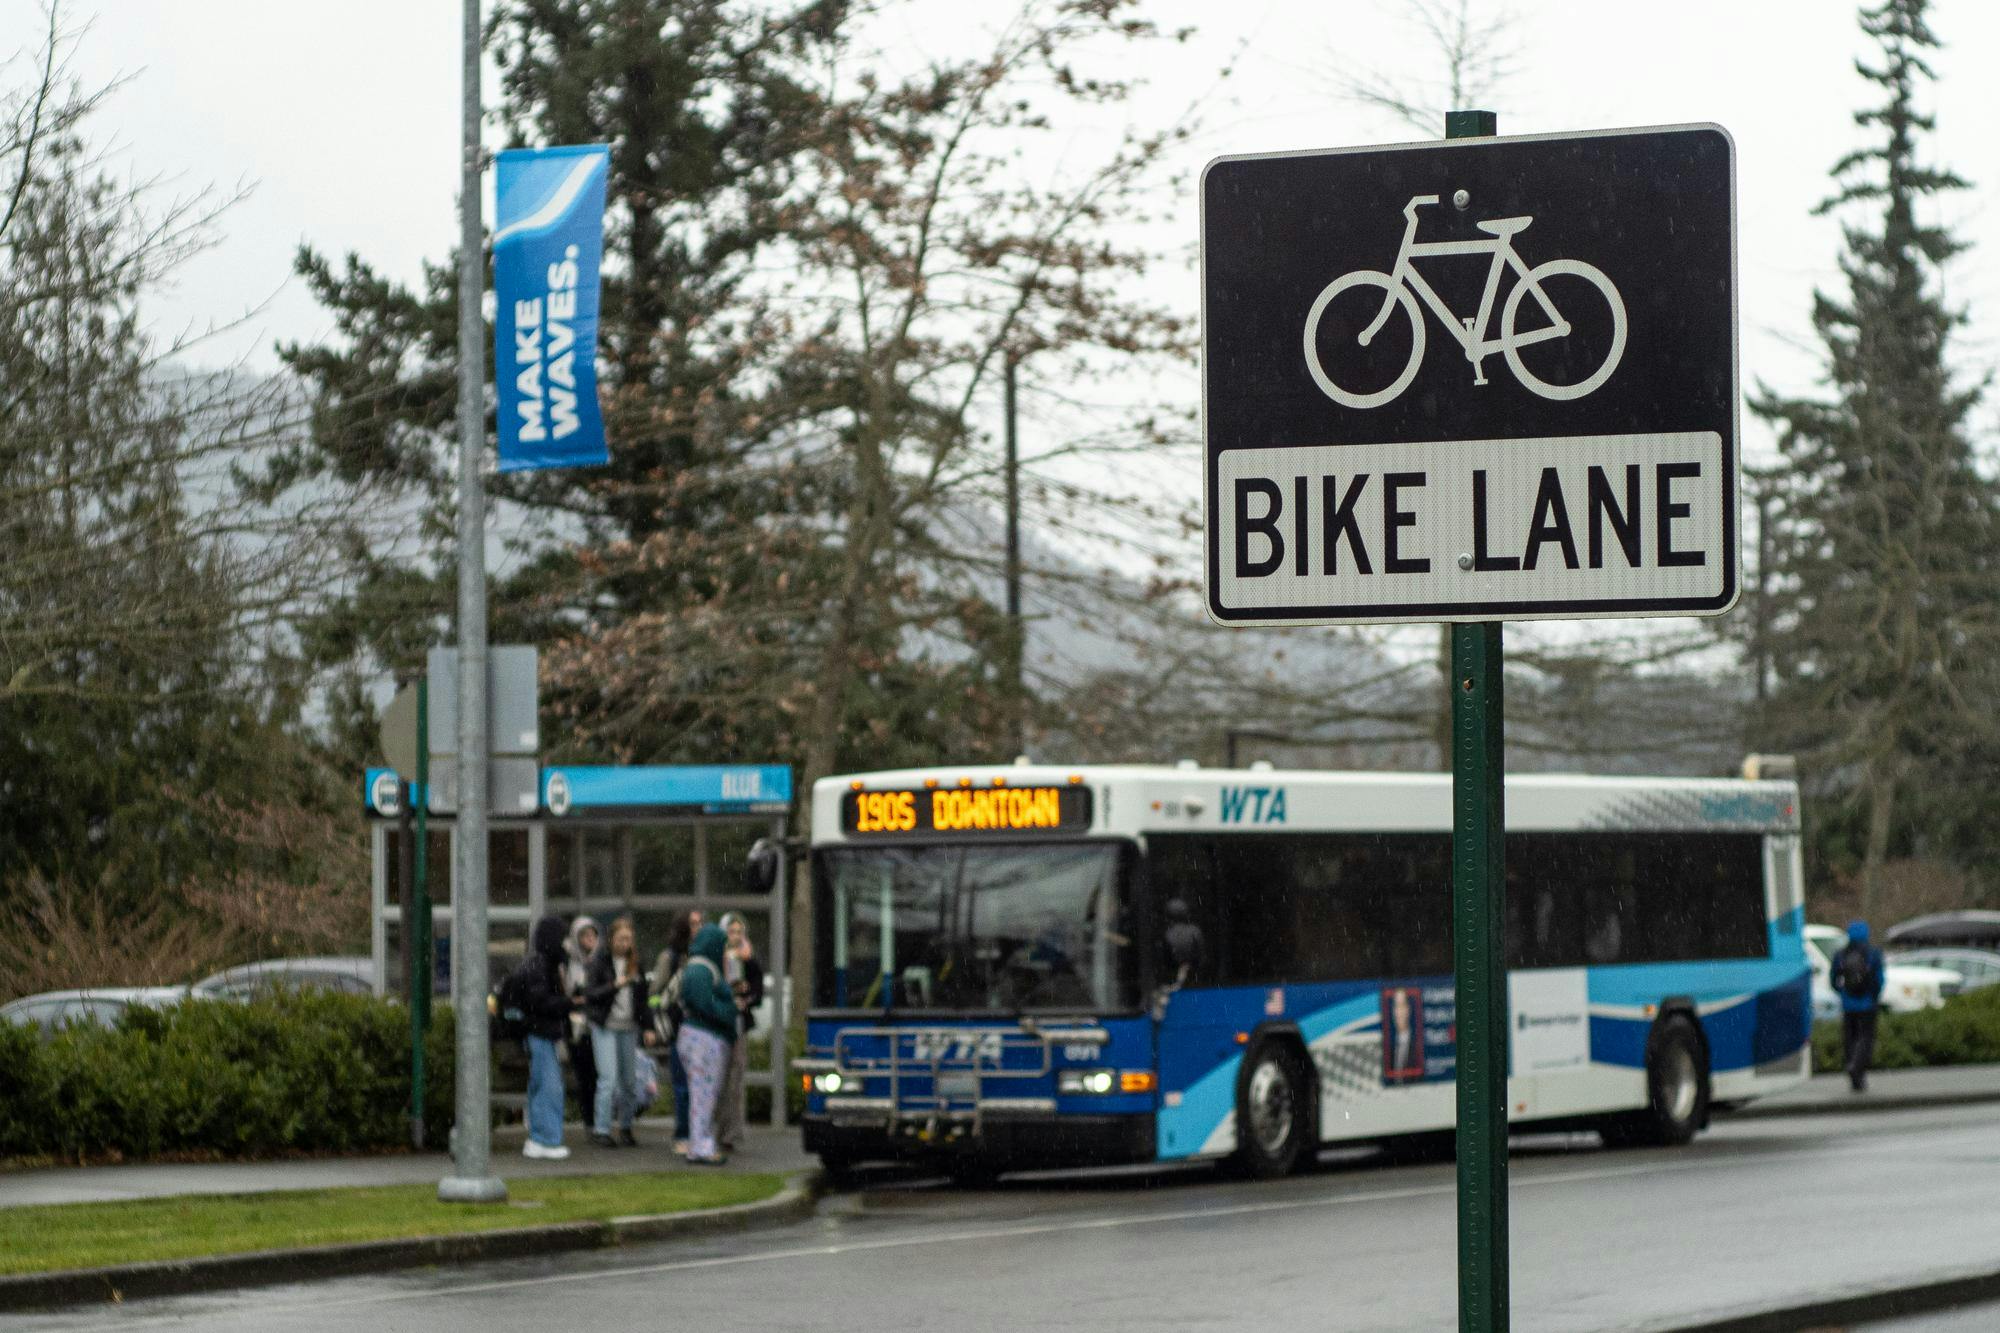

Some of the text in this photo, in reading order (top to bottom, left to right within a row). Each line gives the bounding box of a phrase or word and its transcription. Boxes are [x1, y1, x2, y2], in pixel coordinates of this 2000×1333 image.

[515, 297, 547, 442] MAKE
[547, 244, 581, 440] WAVES.
[1235, 462, 1706, 578] BIKE LANE
[932, 788, 1060, 830] DOWNTOWN
[1220, 785, 1287, 823] WTA
[913, 1031, 1003, 1061] WTA
